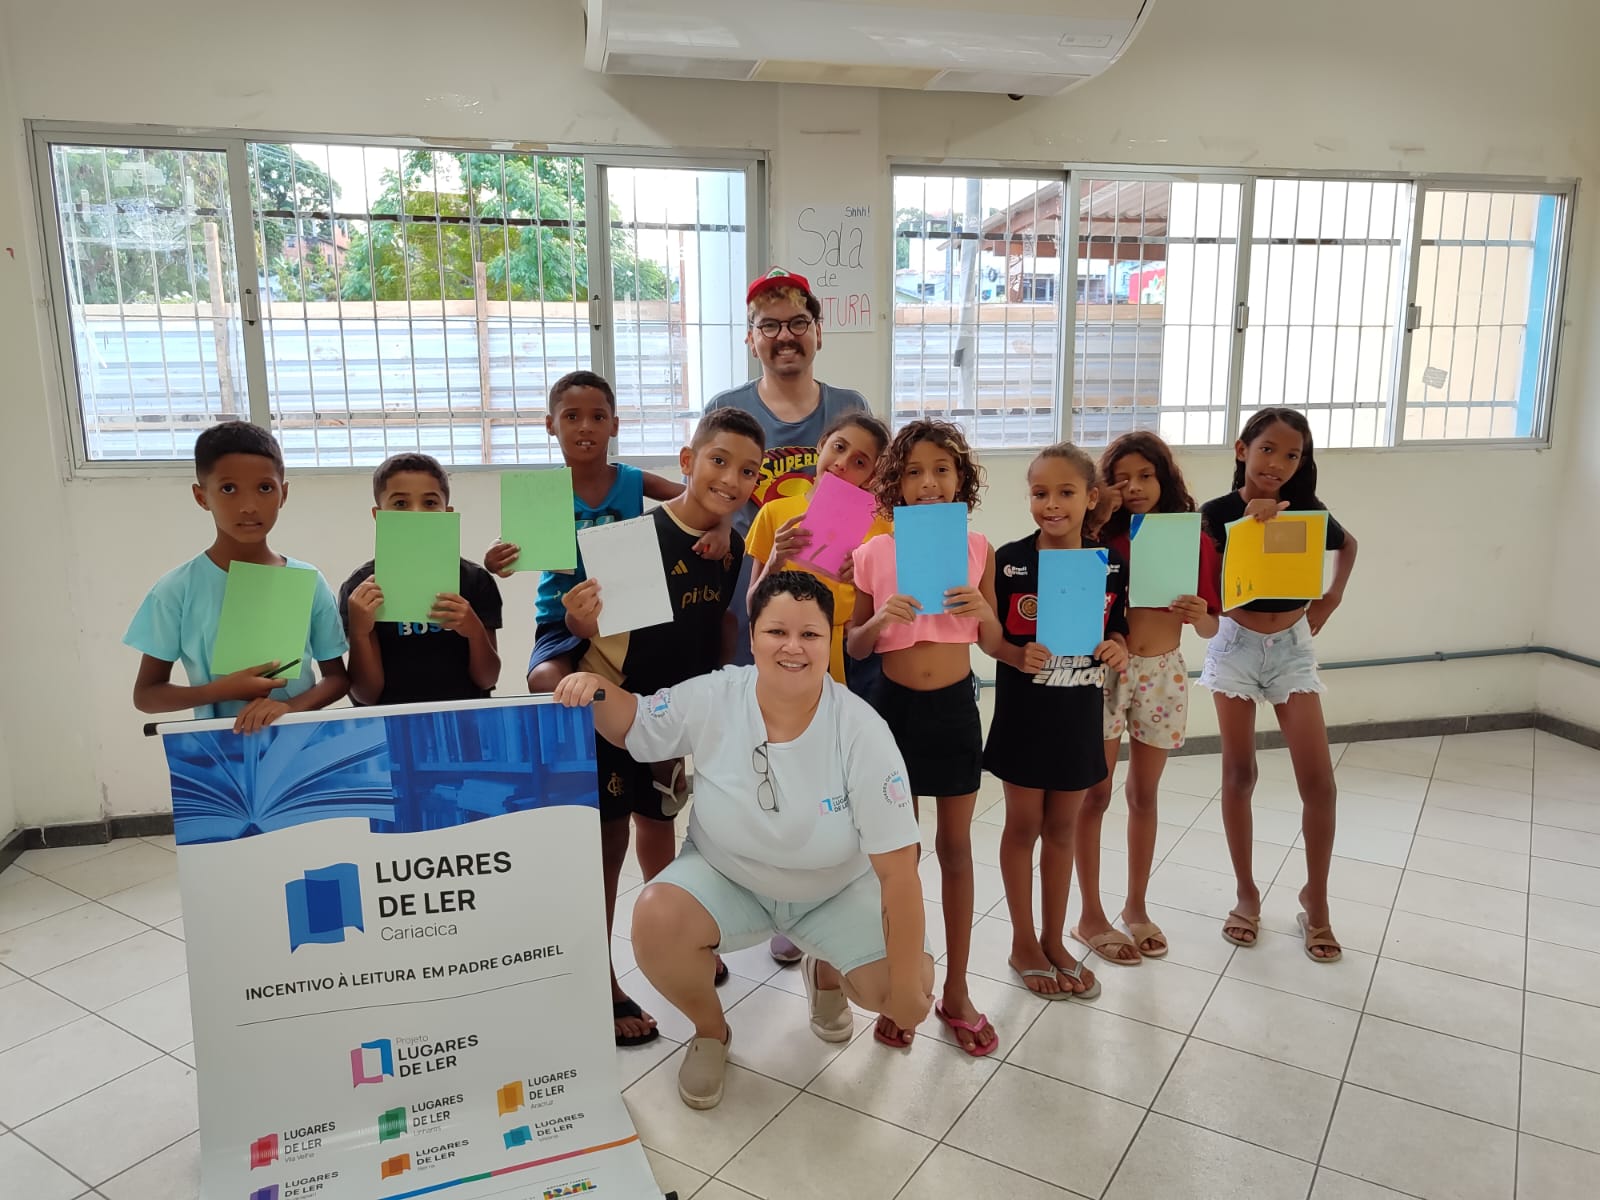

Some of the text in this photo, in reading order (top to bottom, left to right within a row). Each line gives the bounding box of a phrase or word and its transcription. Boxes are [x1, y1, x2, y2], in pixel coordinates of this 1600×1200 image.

[797, 207, 864, 269] Sala
[816, 269, 841, 288] de
[819, 293, 871, 327] ITURA
[375, 850, 512, 884] LUGARES
[378, 888, 477, 919] DE LER
[380, 921, 458, 942] Cariacica
[245, 944, 564, 1001] INCENTIVO À LEITURA EM PADRE GABRIEL
[395, 1034, 429, 1048] Projeto
[398, 1034, 479, 1061] LUGARES
[399, 1055, 457, 1078] DE LER
[527, 1069, 577, 1087] LUGARES
[529, 1083, 565, 1101] DE LER
[411, 1093, 464, 1113] LUGARES
[413, 1110, 451, 1128] DE LER
[283, 1121, 336, 1141] LUGARES
[536, 1123, 574, 1137] DE LER
[284, 1138, 322, 1155] DE LER
[415, 1139, 470, 1157] LUGARES
[416, 1150, 456, 1166] DE LER
[285, 1171, 339, 1189] LUGARES
[284, 1189, 300, 1198] DE
[302, 1183, 324, 1194] LER
